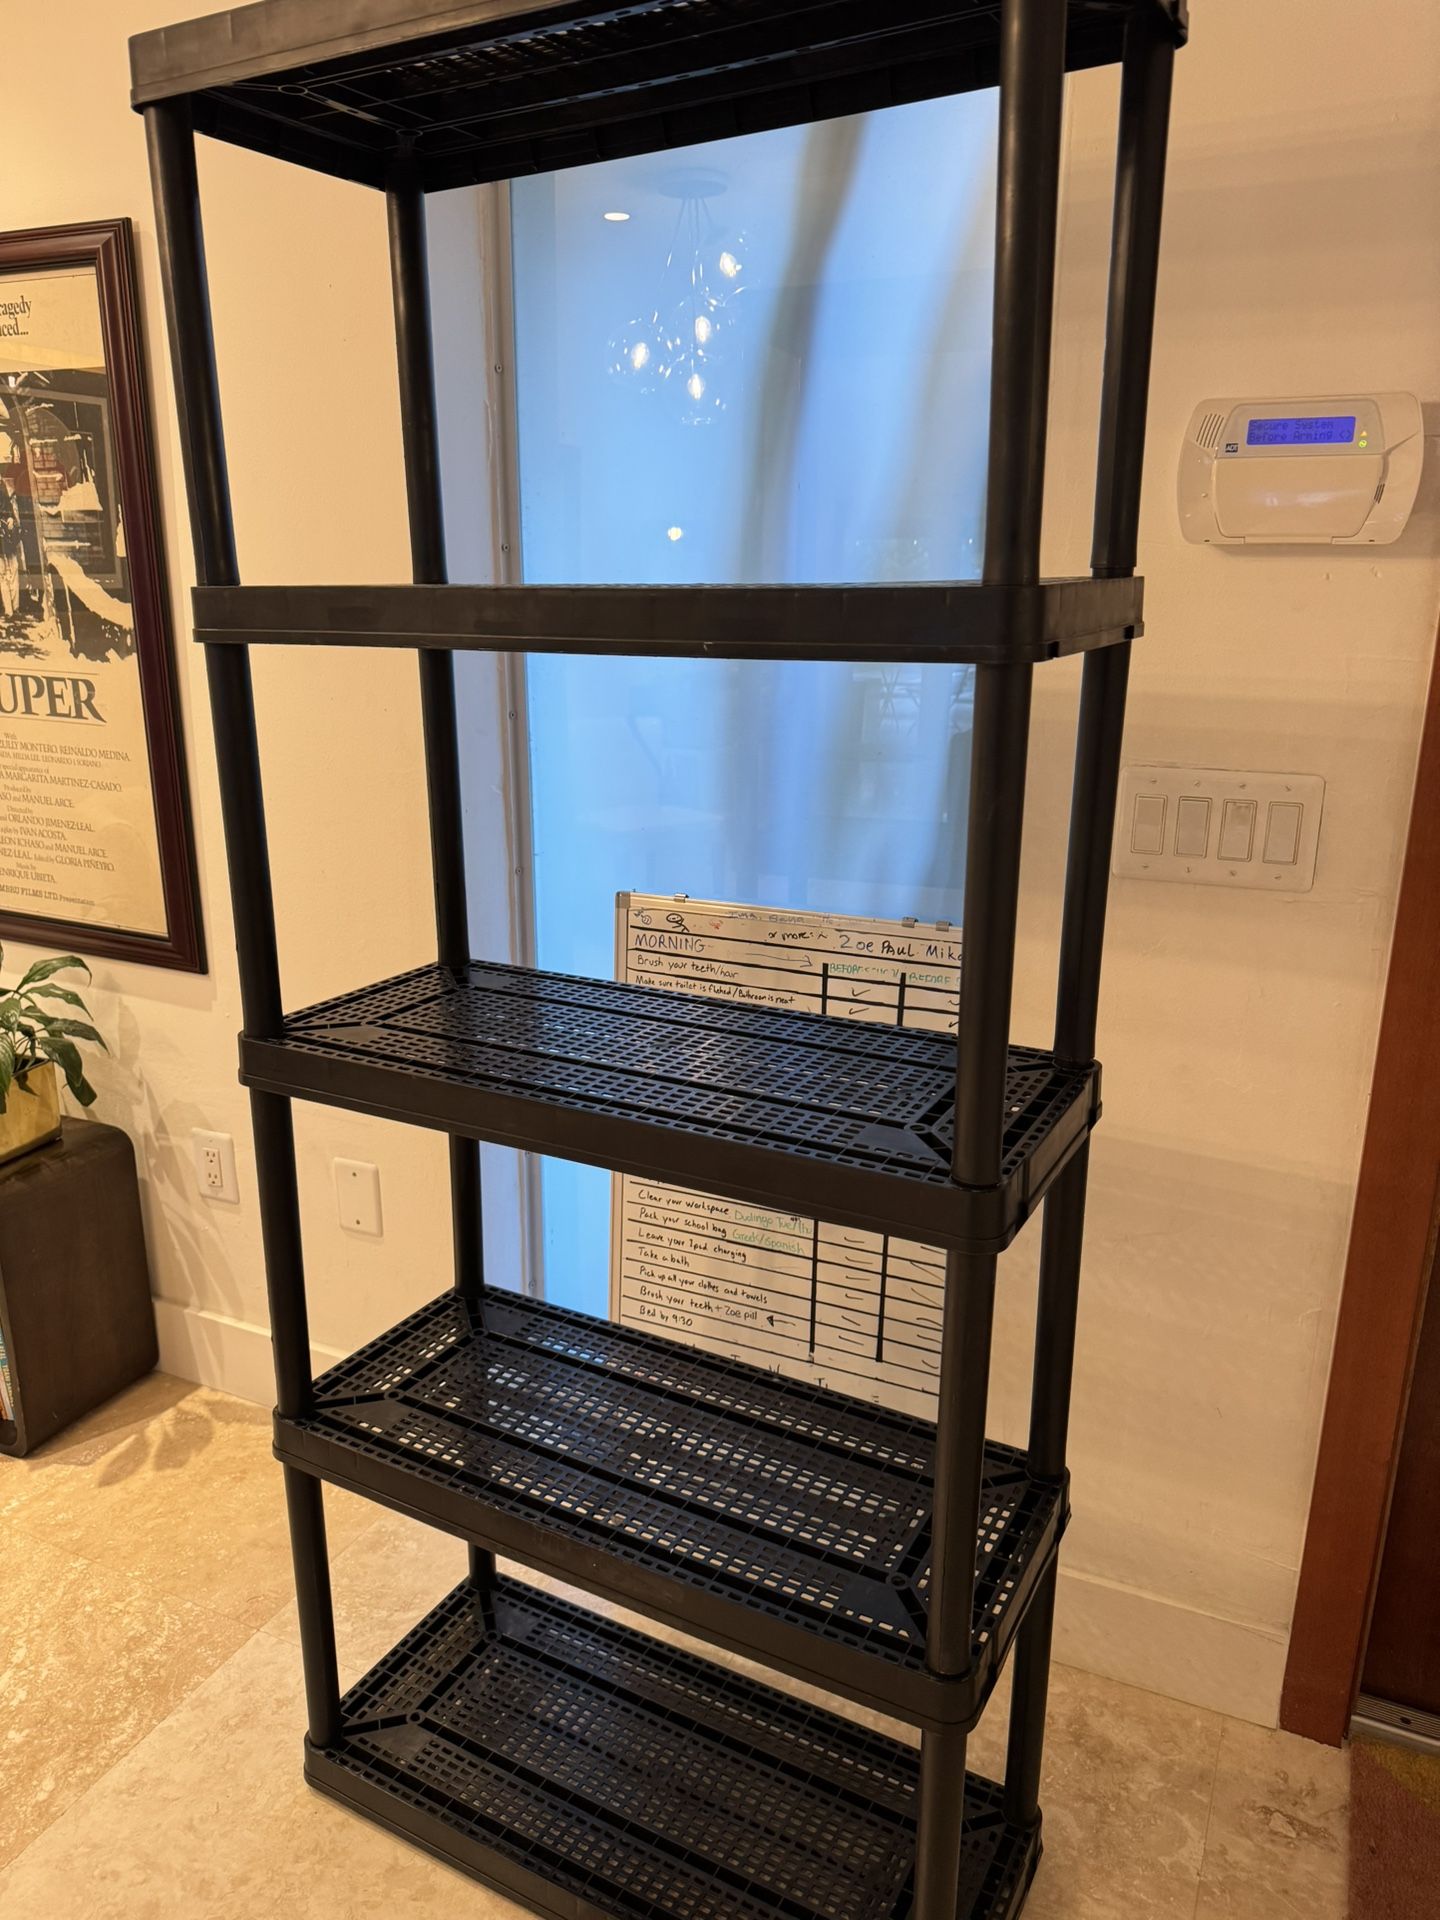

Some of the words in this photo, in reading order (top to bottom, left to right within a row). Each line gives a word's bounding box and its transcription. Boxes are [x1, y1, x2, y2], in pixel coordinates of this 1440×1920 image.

[1295, 420, 1334, 430] System
[1249, 431, 1288, 441] Before
[1293, 431, 1333, 441] Arming
[22, 794, 54, 806] MANUEL
[8, 813, 44, 825] ORLANDO
[55, 843, 87, 856] MANUEL
[21, 887, 43, 898] FILMS
[635, 933, 706, 952] MORNING
[637, 955, 664, 967] Brush
[668, 961, 688, 970] your
[635, 975, 655, 986] Make
[658, 979, 673, 988] sure
[675, 979, 697, 990] toilet
[699, 983, 707, 992] is
[638, 1189, 662, 1202] Clear
[665, 1198, 682, 1206] your
[685, 1201, 730, 1215] workspace
[639, 1206, 658, 1219] Pack
[662, 1216, 680, 1225] your
[684, 1219, 709, 1231] school
[712, 1223, 727, 1238] bag
[638, 1227, 664, 1242] Leave
[667, 1237, 685, 1247] your
[713, 1245, 746, 1263] charging
[638, 1247, 658, 1260] Take
[670, 1253, 690, 1267] bath
[640, 1265, 654, 1278] Pick
[657, 1273, 665, 1282] up
[667, 1274, 677, 1283] all
[679, 1278, 695, 1287] your
[698, 1279, 719, 1293] clothes
[724, 1287, 738, 1296] and
[742, 1289, 768, 1304] towels
[640, 1285, 663, 1300] Brush
[666, 1295, 684, 1305] your
[690, 1298, 714, 1313] teeth
[743, 1310, 758, 1321] pill
[640, 1305, 656, 1318] Bed
[660, 1312, 669, 1322] by
